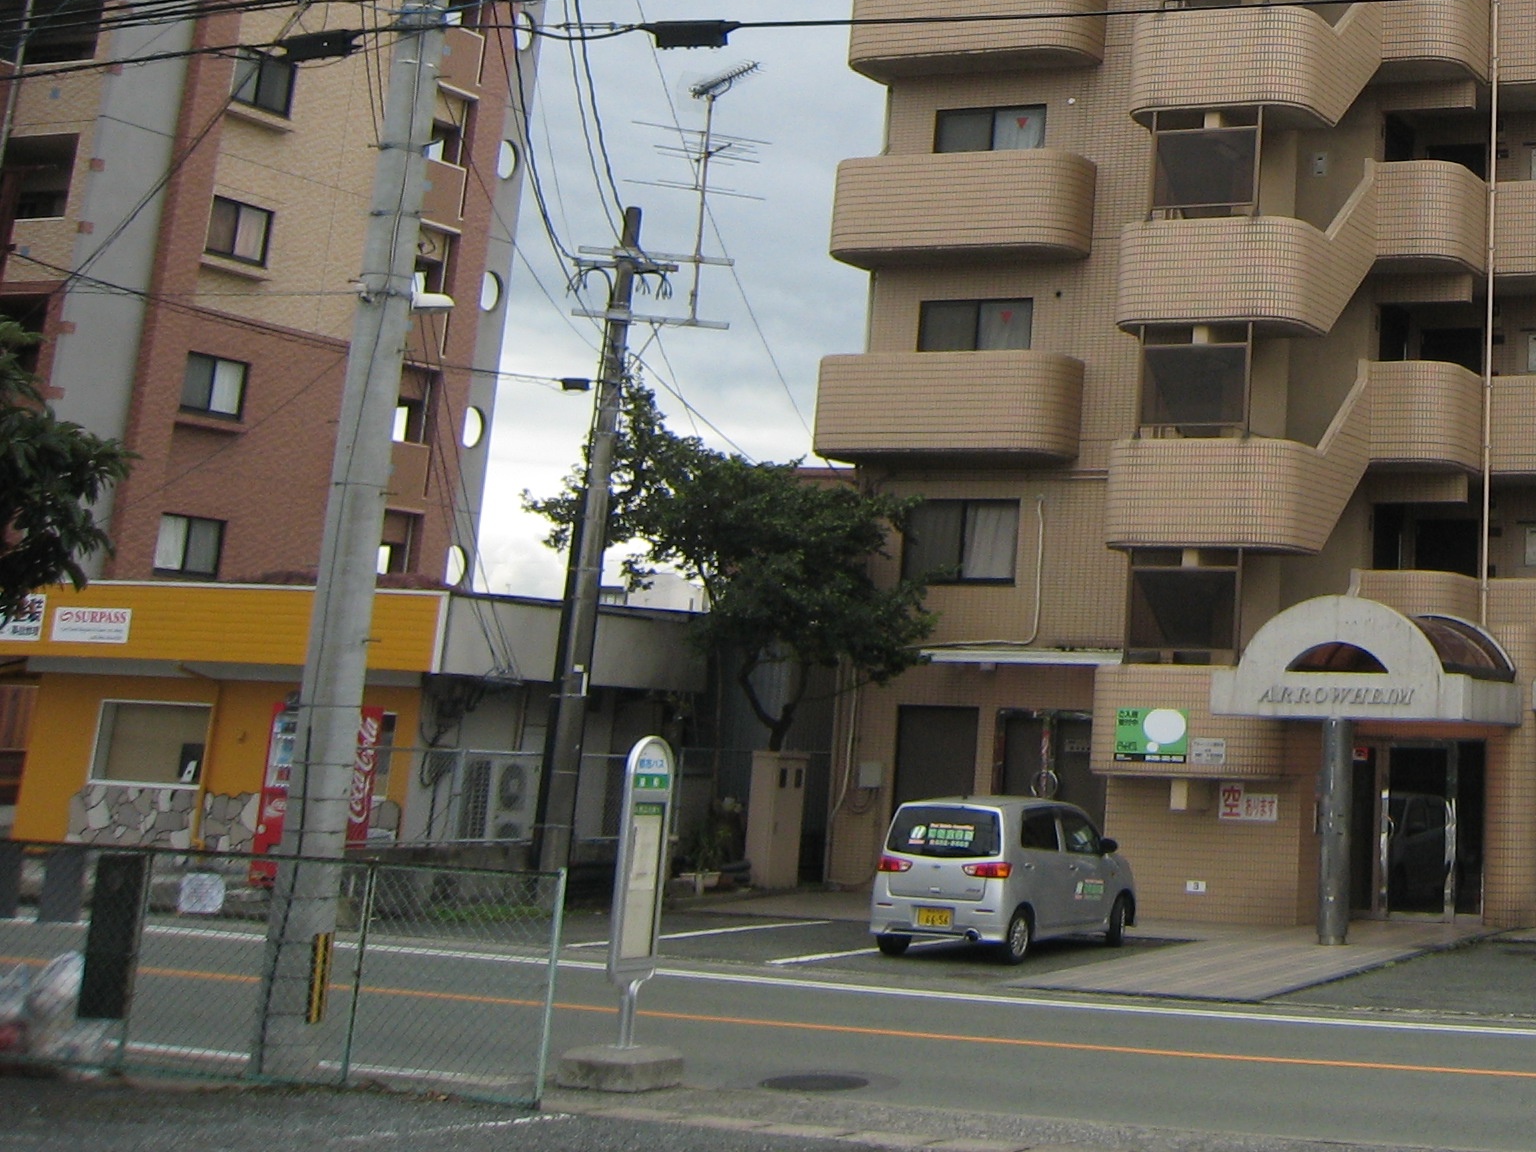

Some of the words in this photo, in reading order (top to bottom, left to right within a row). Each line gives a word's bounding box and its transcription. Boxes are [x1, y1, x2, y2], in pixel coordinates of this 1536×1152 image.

[74, 610, 127, 624] SURPASS
[1257, 684, 1416, 706] ARROWHEIM
[1222, 785, 1241, 817] 空
